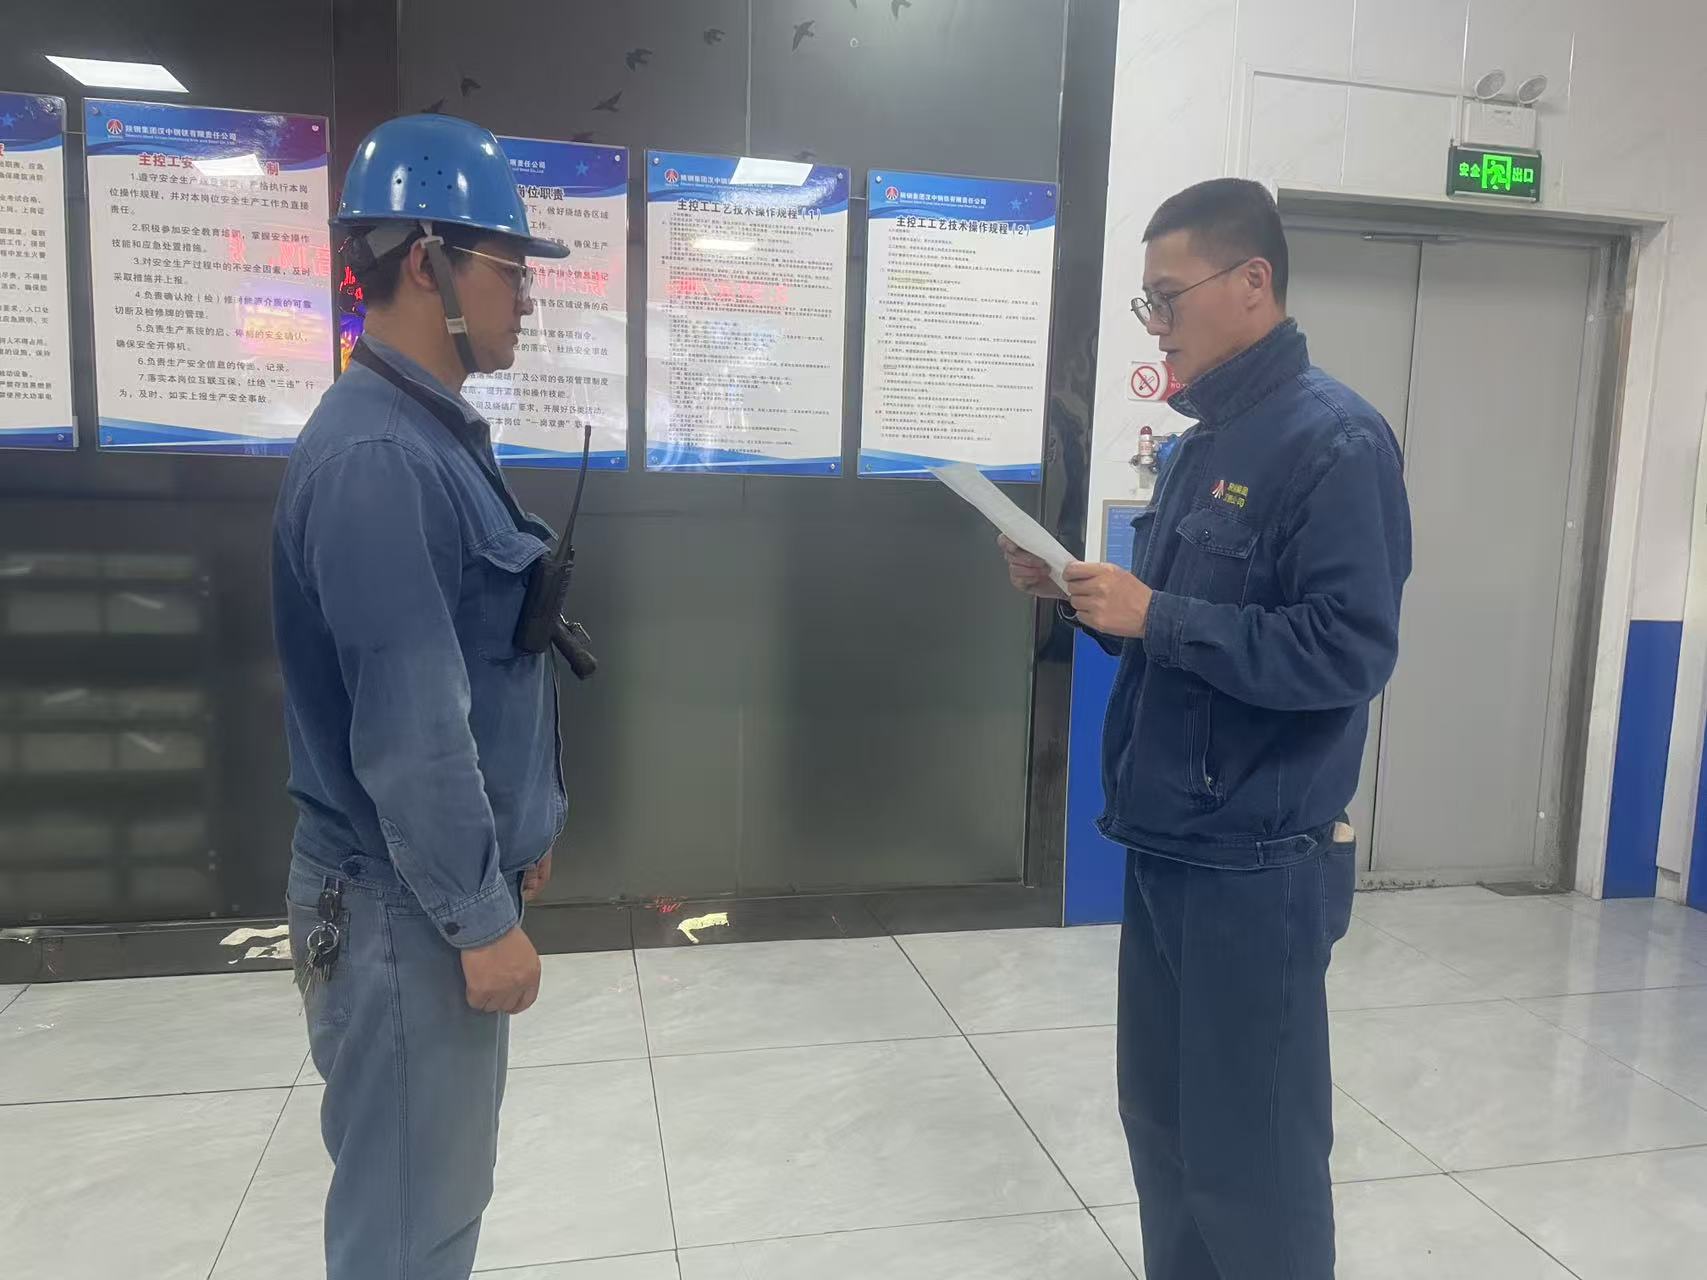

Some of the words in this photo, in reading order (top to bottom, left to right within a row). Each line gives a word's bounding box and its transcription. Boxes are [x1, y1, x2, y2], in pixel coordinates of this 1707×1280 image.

[1459, 162, 1480, 178] 安全
[1512, 167, 1534, 183] 出口
[110, 188, 309, 210] 位操作规程，并对本岗位安全生产工作负直接
[111, 205, 135, 215] 责任。
[112, 239, 207, 253] 技能和应急处置措施。
[114, 272, 188, 285] 采取措施并上报。
